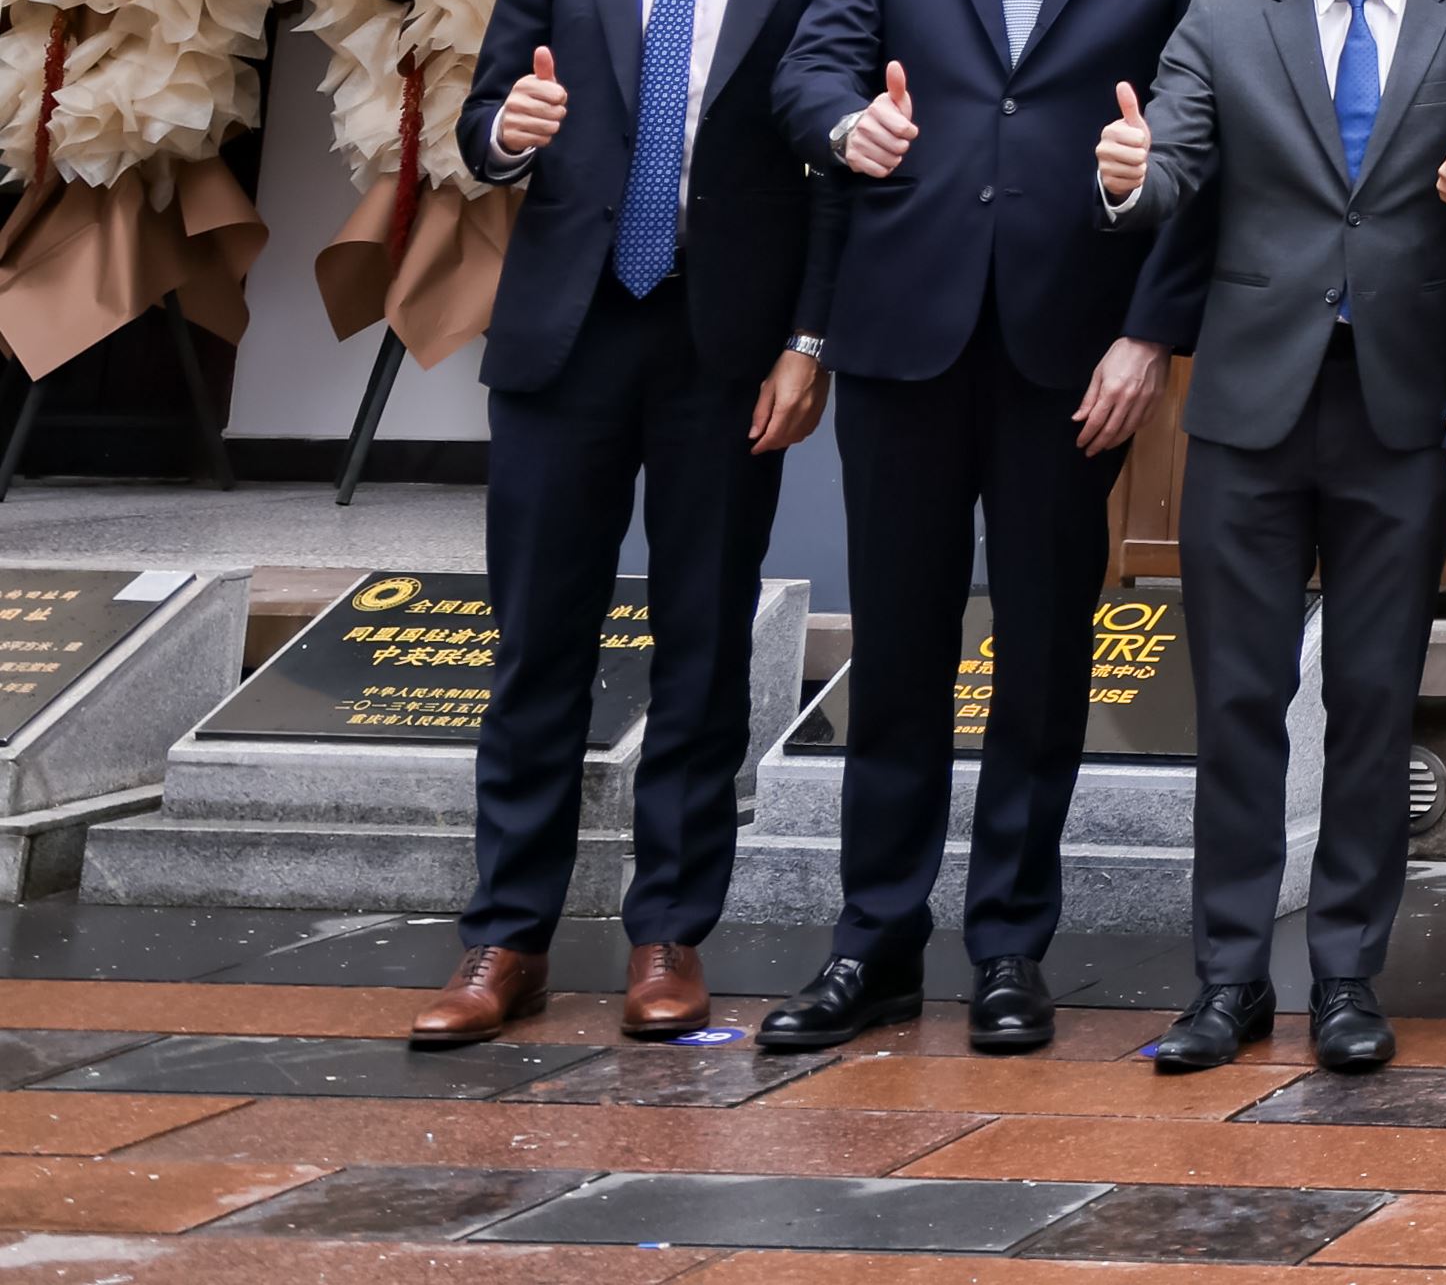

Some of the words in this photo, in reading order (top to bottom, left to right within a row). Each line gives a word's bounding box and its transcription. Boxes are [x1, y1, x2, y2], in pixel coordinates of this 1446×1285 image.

[342, 626, 500, 645] 同盟国驻渝外
[372, 645, 496, 667] 中英联络
